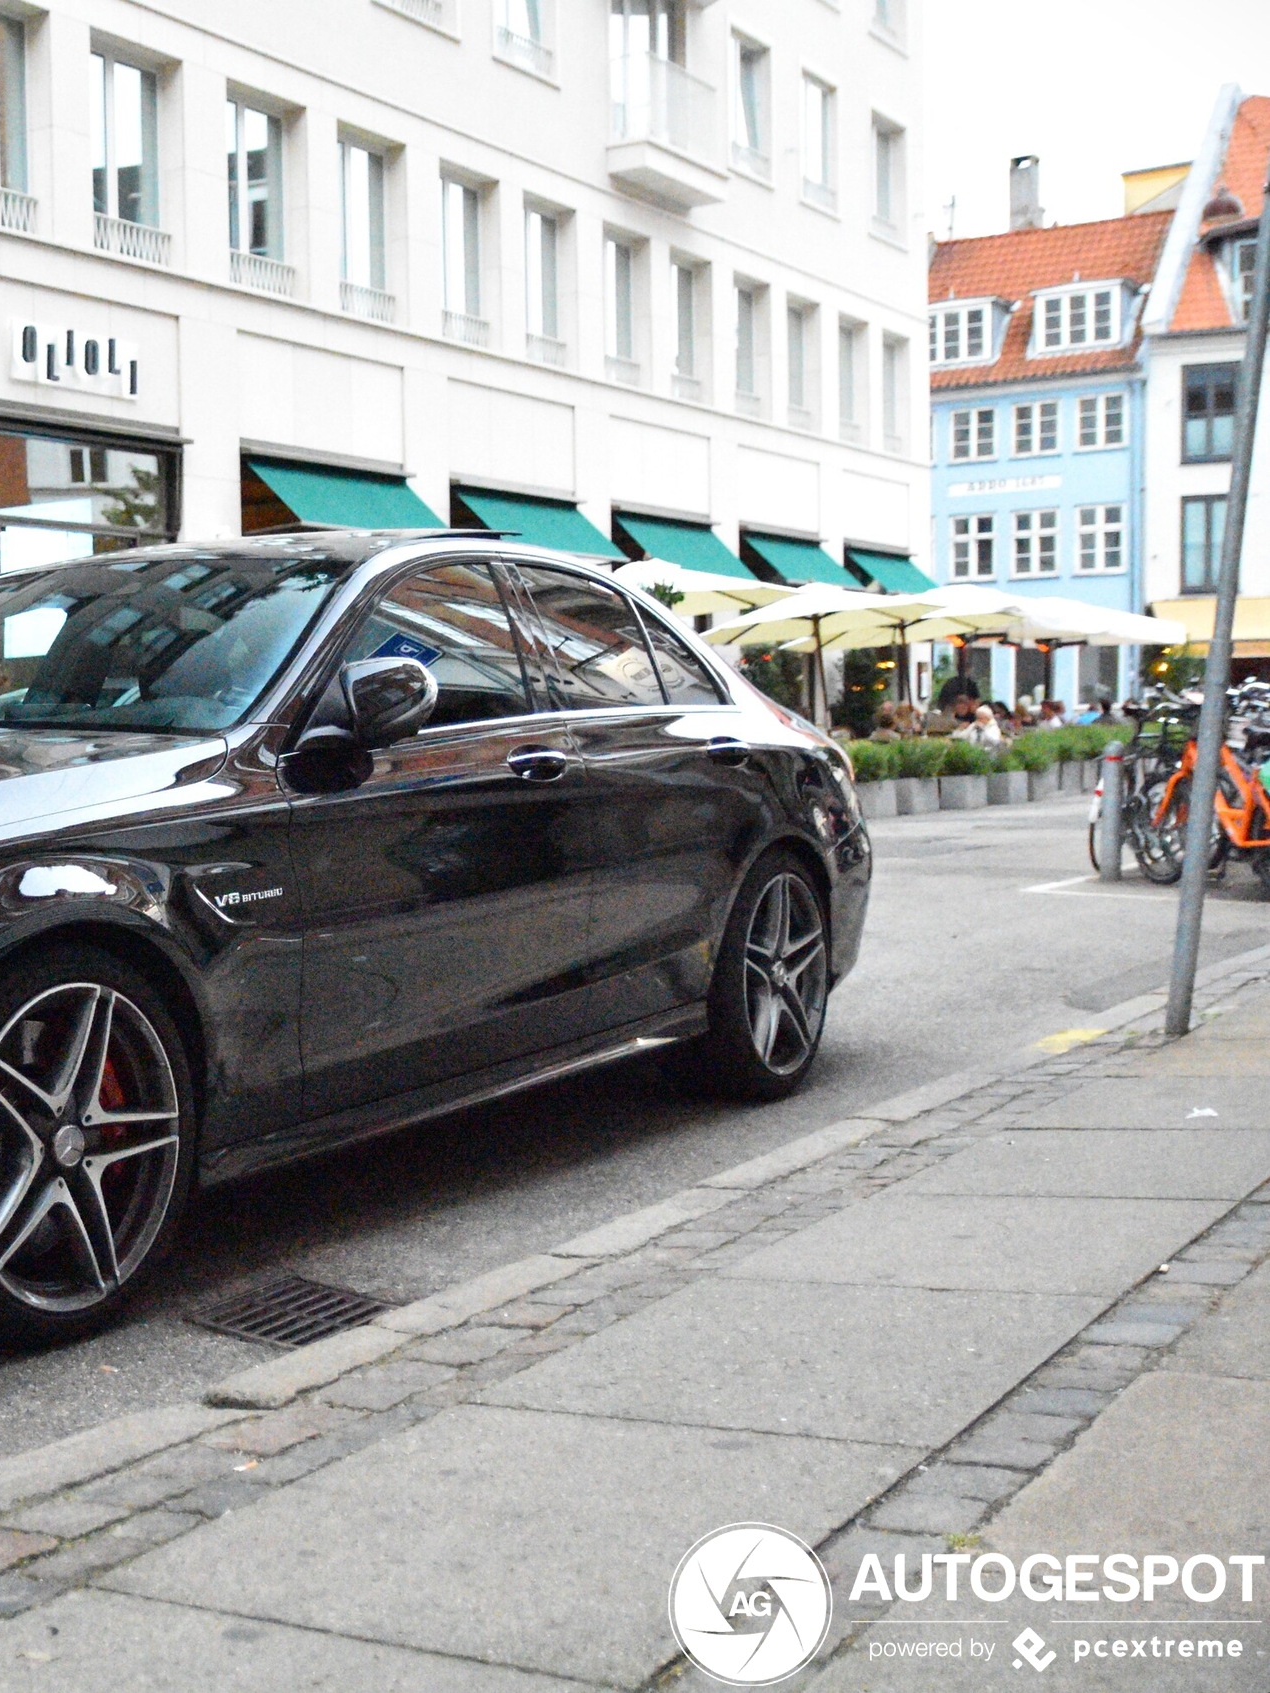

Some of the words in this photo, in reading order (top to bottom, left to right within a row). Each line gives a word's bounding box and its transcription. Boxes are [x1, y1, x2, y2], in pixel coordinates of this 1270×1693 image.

[21, 324, 138, 396] OLIOLI
[214, 891, 240, 908] V8
[241, 887, 284, 903] BITURBO
